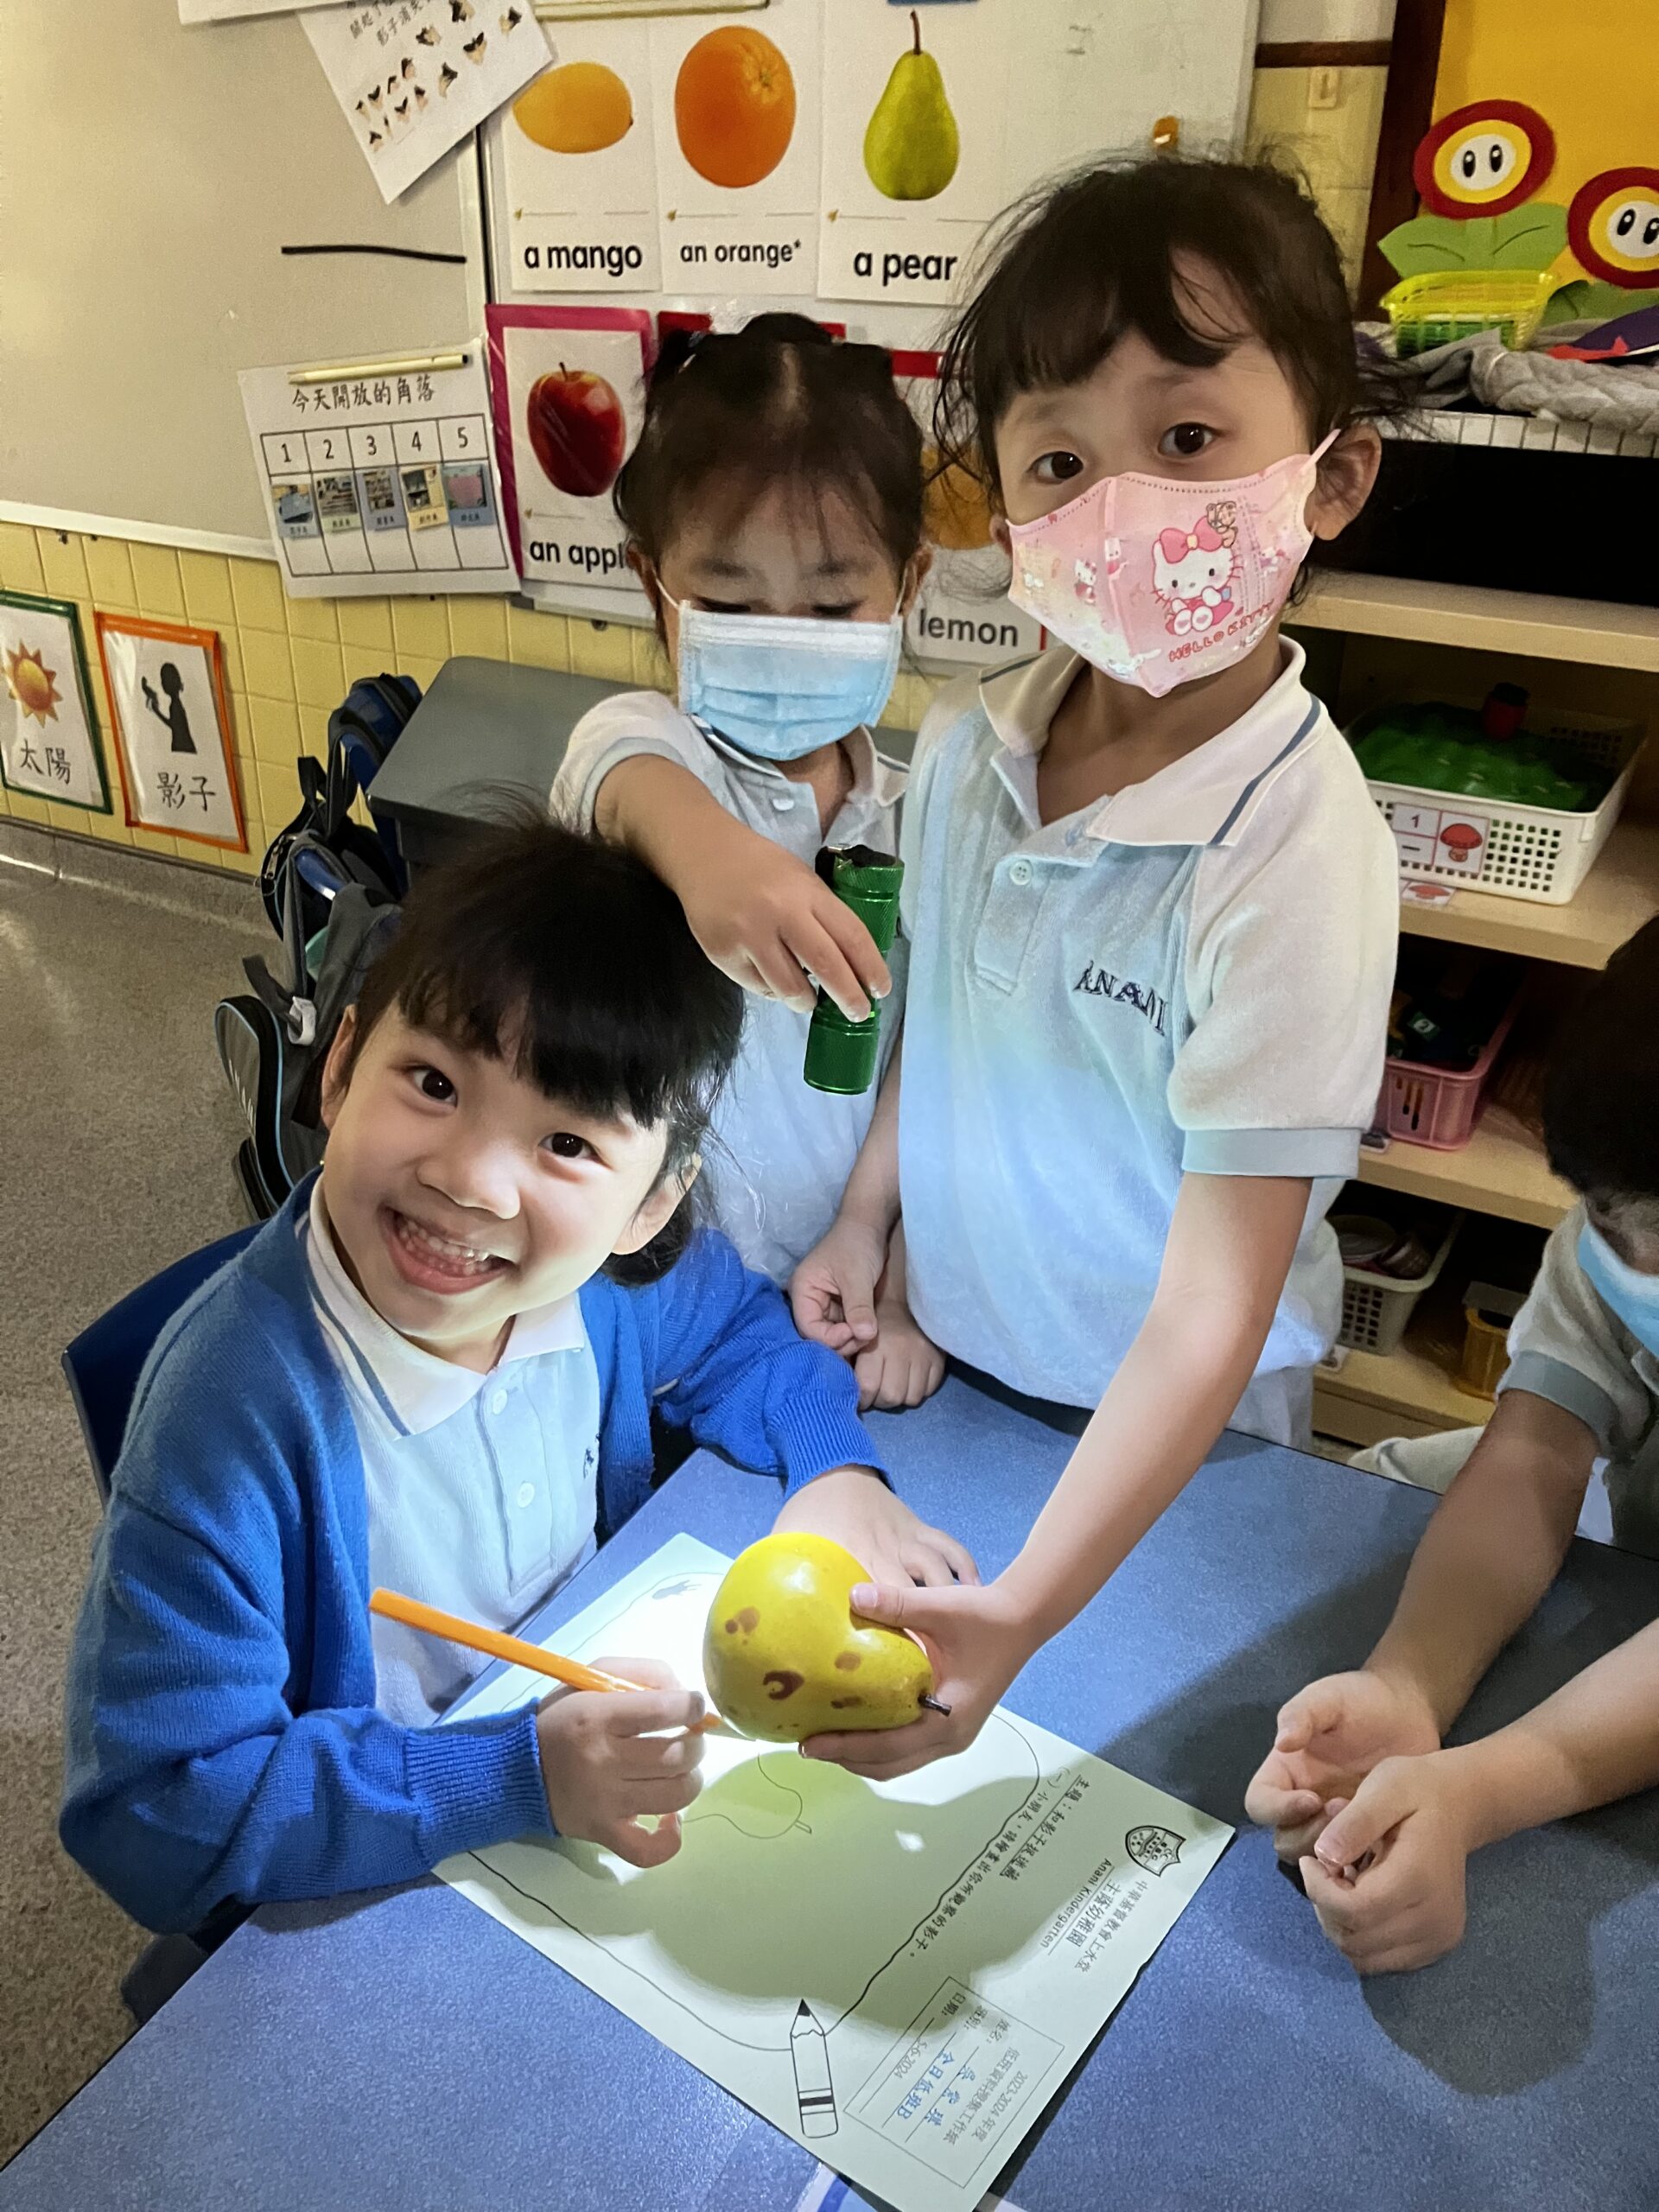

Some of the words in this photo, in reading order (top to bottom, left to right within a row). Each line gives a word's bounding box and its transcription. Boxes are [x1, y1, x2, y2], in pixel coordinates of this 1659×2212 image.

[524, 245, 539, 269] a
[547, 245, 642, 276] mango
[680, 244, 707, 263] an
[854, 251, 873, 276] a
[882, 253, 957, 287] pear
[292, 373, 435, 413] 今天開放的角落
[281, 442, 292, 462] 1
[322, 439, 334, 460] 2
[365, 435, 378, 456] 3
[411, 430, 423, 452] 4
[457, 426, 468, 448] 5
[530, 541, 561, 563] an
[568, 542, 626, 574] appl
[918, 607, 1018, 647] lemon
[1168, 630, 1224, 663] HELLO
[20, 738, 72, 785] 太陽
[157, 772, 215, 812] 影子
[1411, 813, 1421, 829] 1
[1087, 1857, 1112, 1886] Anani
[1039, 1885, 1091, 1950] Kindergarten
[1065, 1878, 1122, 1948] 主蔭幼稚園
[893, 2037, 929, 2080] 5-6-2024
[988, 2069, 1028, 2118] 2023-2024
[970, 2114, 996, 2143] 年度
